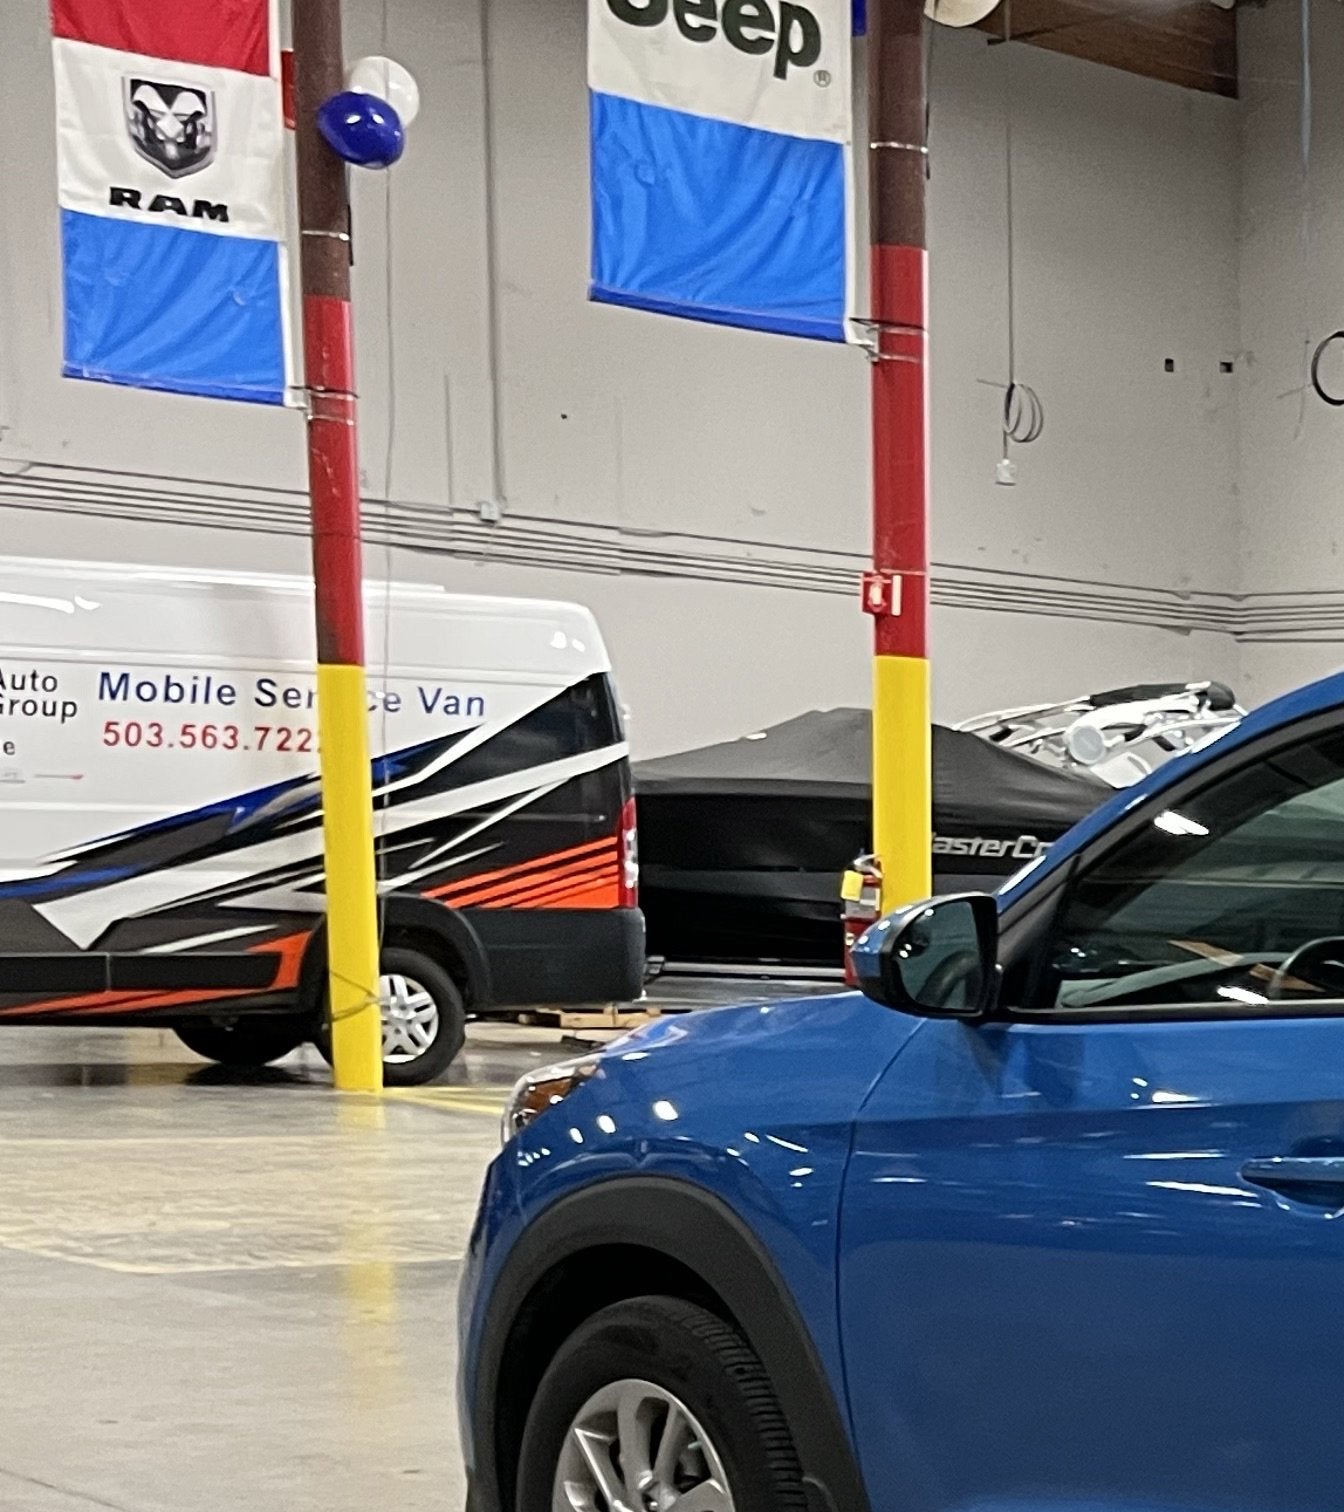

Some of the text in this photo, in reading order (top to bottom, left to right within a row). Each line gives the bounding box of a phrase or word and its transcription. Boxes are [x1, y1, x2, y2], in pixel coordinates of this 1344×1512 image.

[109, 186, 229, 222] RAM
[98, 672, 236, 706] Mobile
[418, 686, 485, 716] Van
[103, 720, 321, 752] 503.563.722
[932, 834, 1055, 859] asterCr
